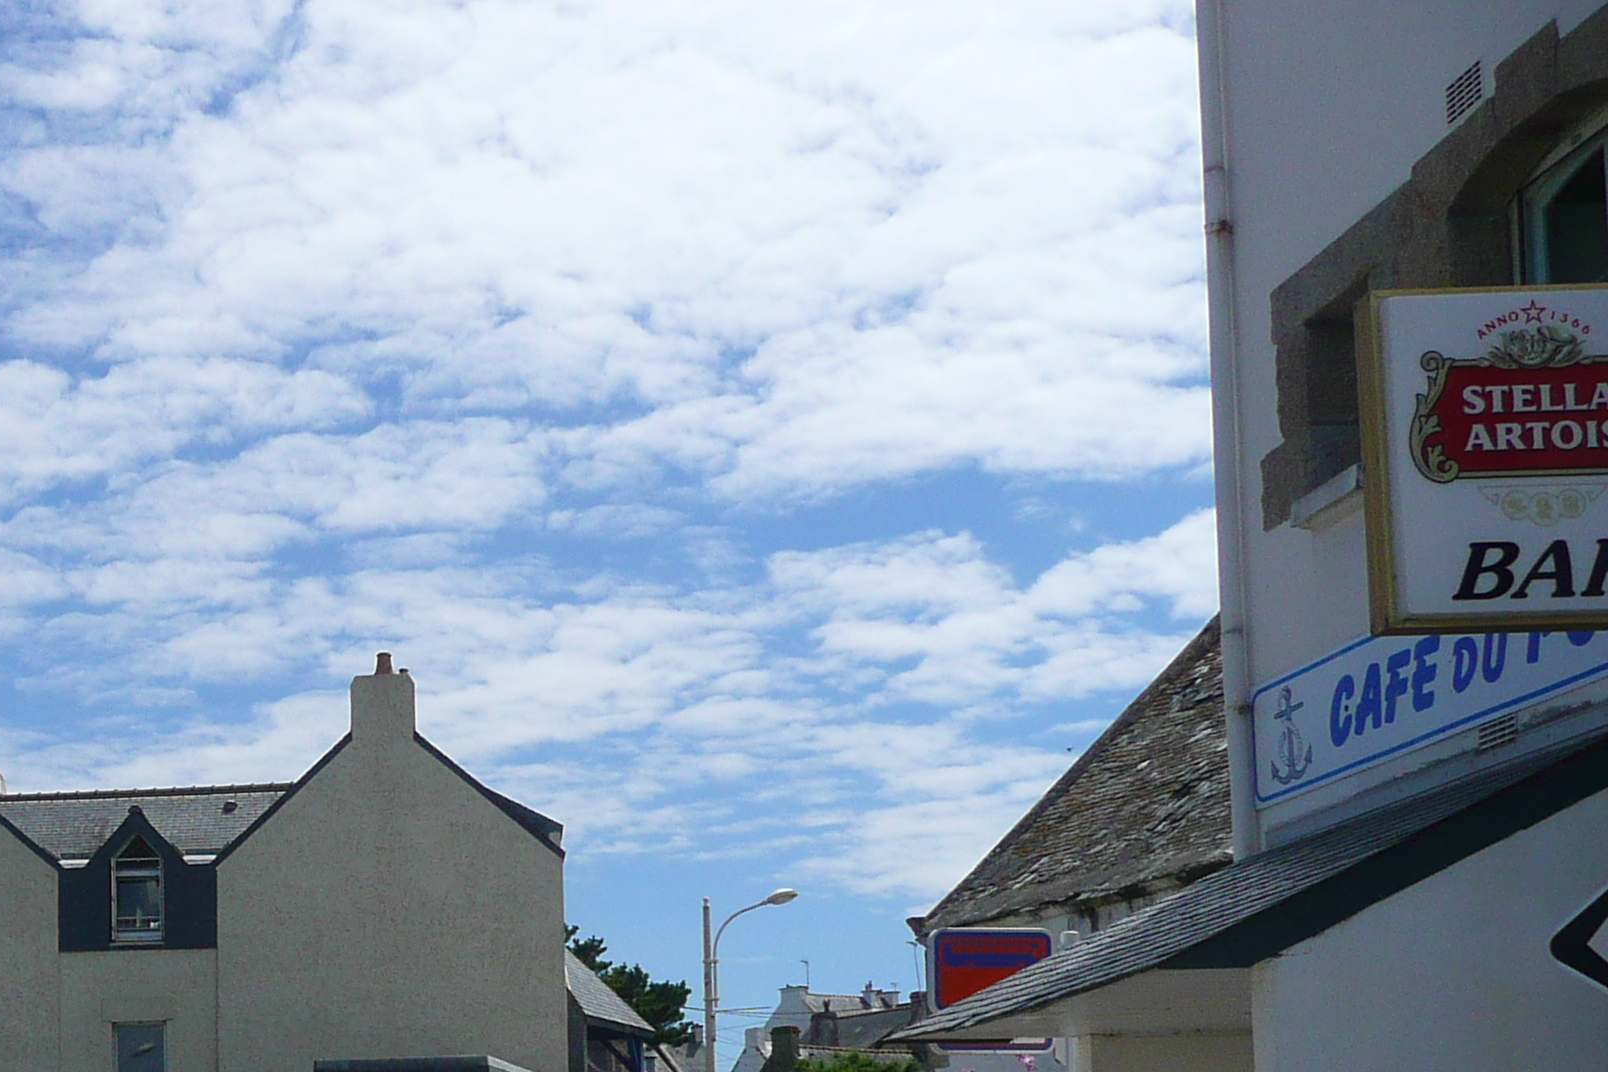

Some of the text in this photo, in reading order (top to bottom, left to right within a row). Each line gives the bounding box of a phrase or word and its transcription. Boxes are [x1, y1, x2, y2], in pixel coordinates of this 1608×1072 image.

[1476, 311, 1591, 340] ANNO 1366
[1462, 382, 1608, 415] STELLA
[1452, 632, 1508, 694] DU
